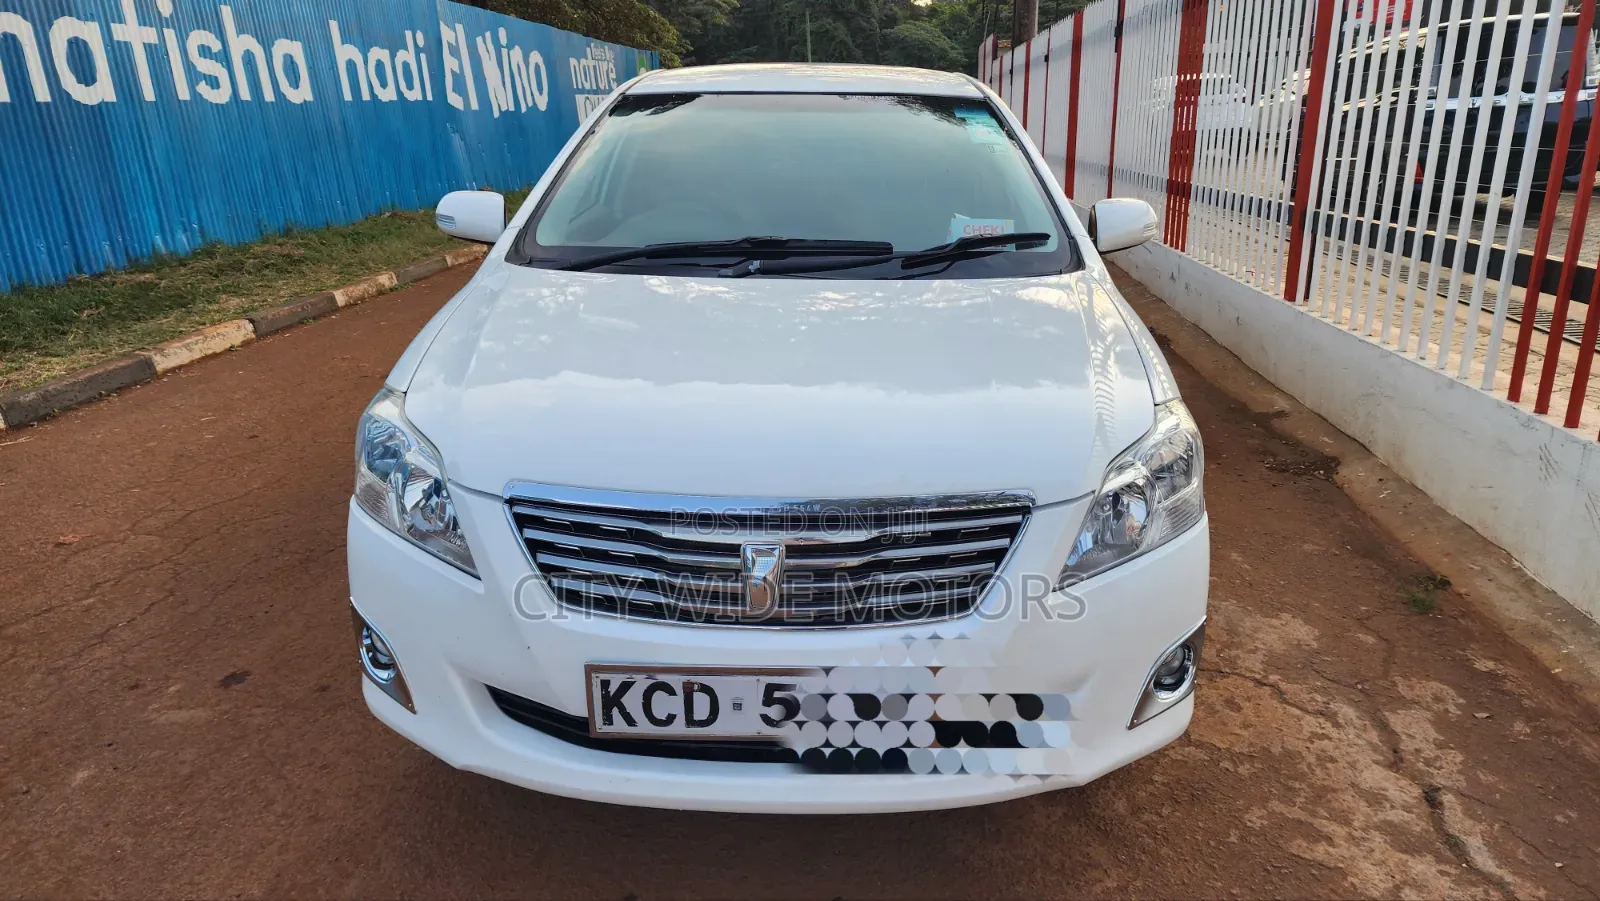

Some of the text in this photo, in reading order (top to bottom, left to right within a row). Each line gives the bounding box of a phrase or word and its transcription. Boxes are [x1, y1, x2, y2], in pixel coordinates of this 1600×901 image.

[329, 20, 432, 101] hadi
[440, 21, 479, 111] El
[476, 27, 548, 118] Nino
[569, 58, 617, 90] nature
[600, 679, 720, 728] KCD
